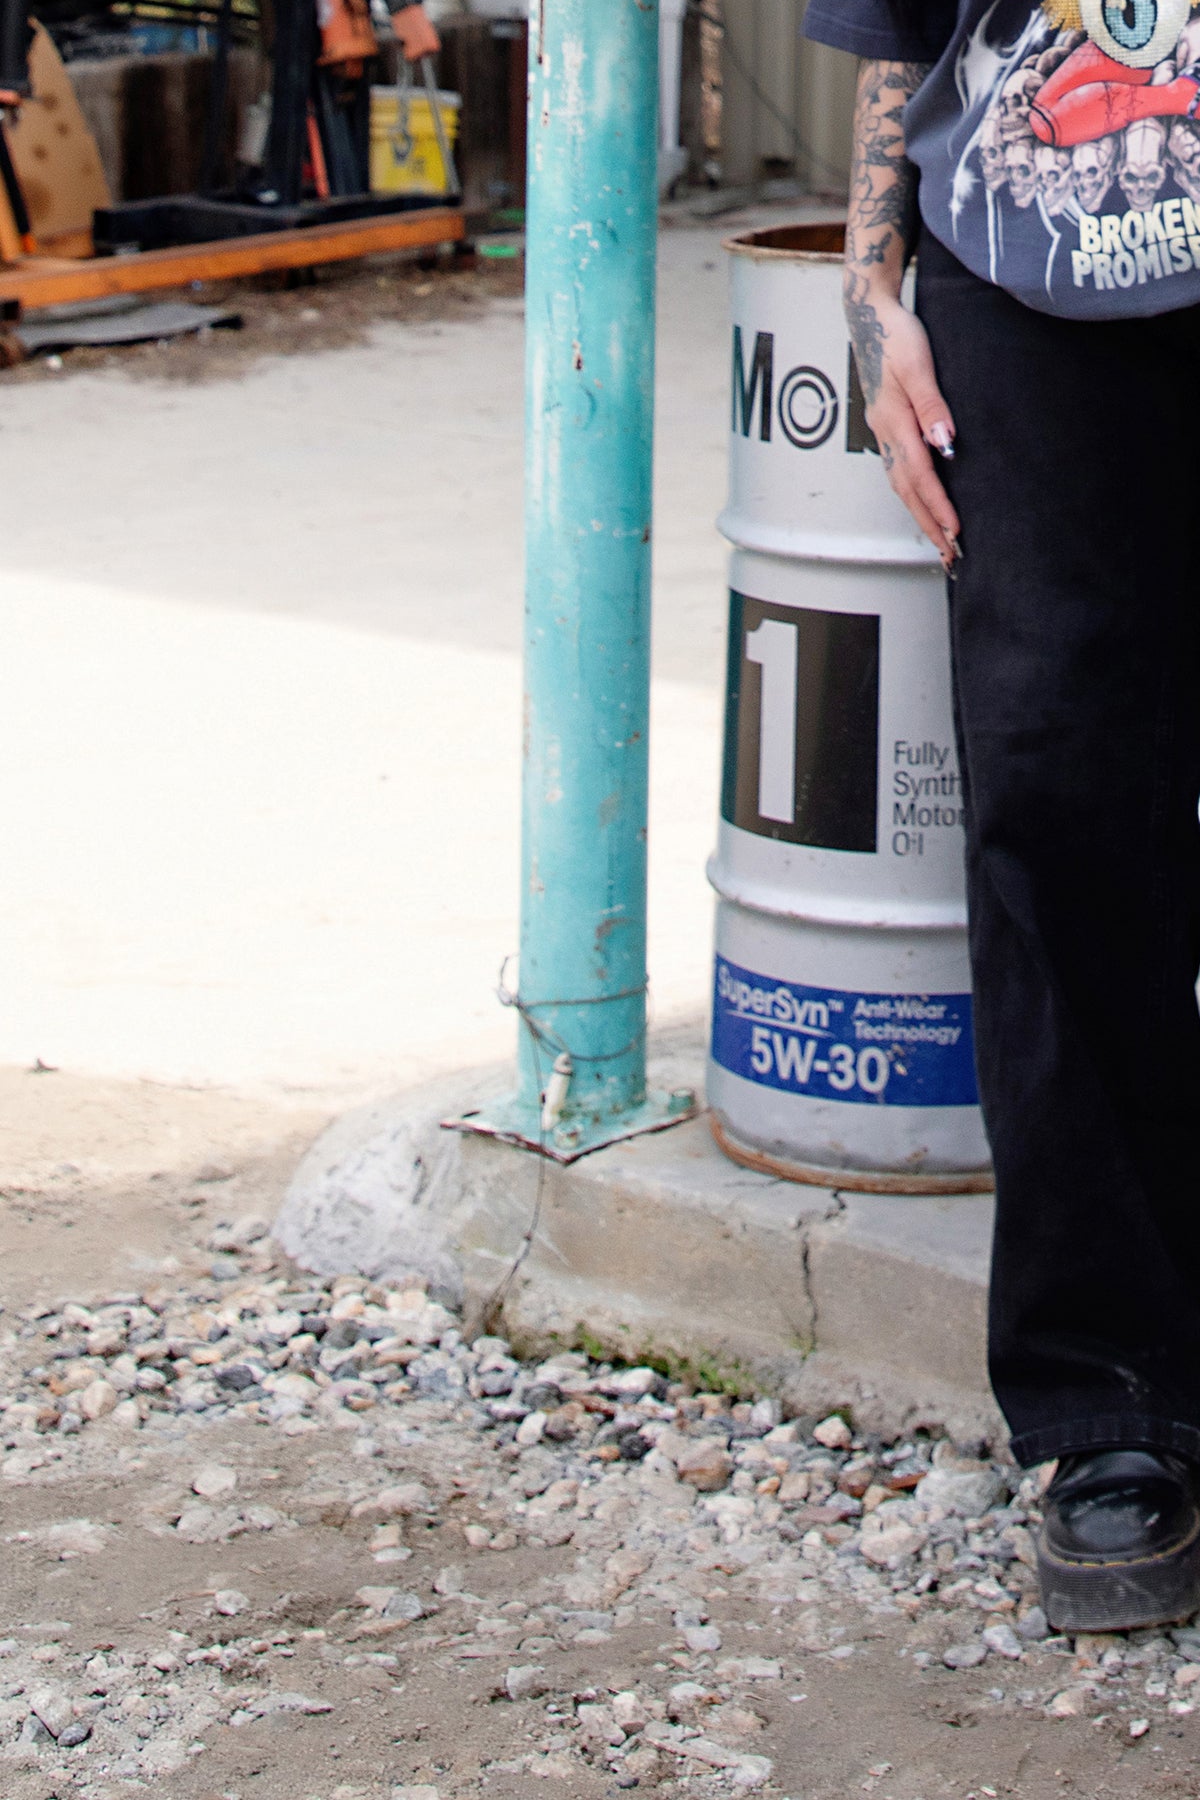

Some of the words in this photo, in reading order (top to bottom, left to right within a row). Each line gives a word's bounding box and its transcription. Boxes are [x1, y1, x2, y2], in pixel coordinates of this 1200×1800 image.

[745, 619, 799, 825] 1
[894, 740, 951, 772] Fully
[892, 831, 925, 857] Oil
[853, 997, 948, 1020] Anti-Wear
[853, 1020, 962, 1046] Technology
[750, 1026, 891, 1095] 5W-30
